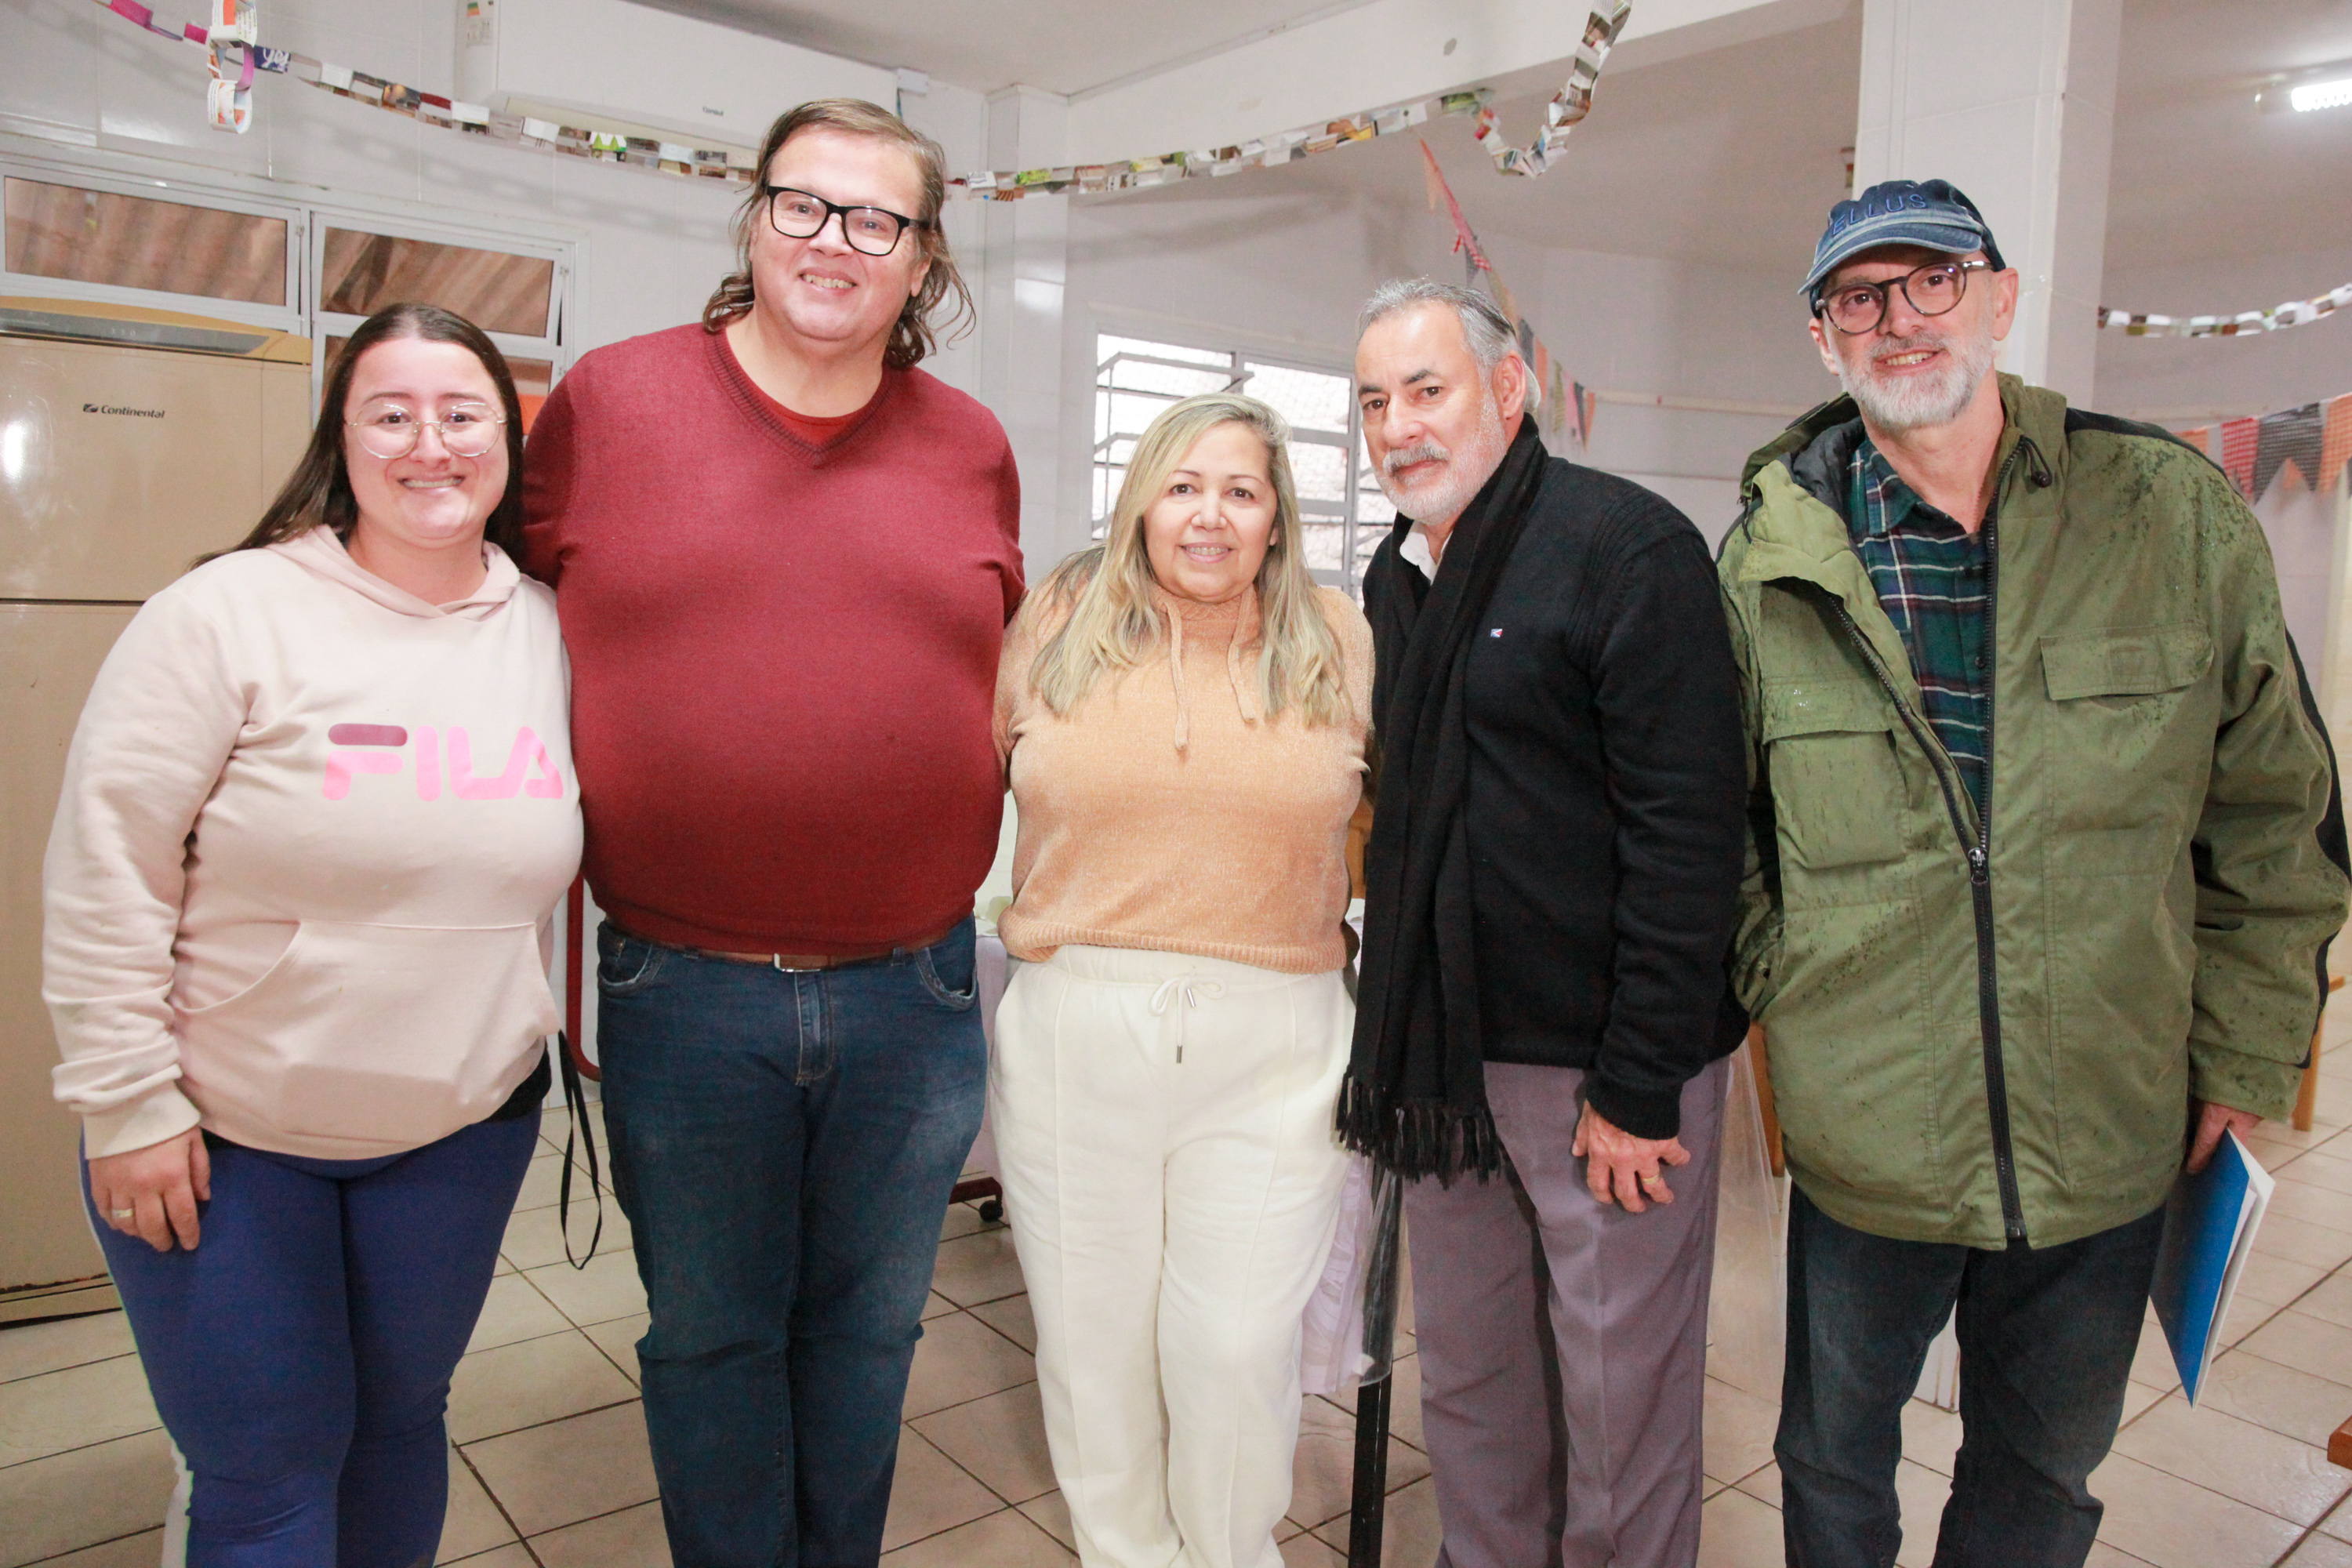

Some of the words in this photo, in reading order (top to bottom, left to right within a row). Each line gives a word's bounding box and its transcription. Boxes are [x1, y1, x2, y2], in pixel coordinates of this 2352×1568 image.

[1832, 194, 1926, 237] ELLUS
[100, 405, 165, 419] Continental
[322, 723, 564, 801] FILA
